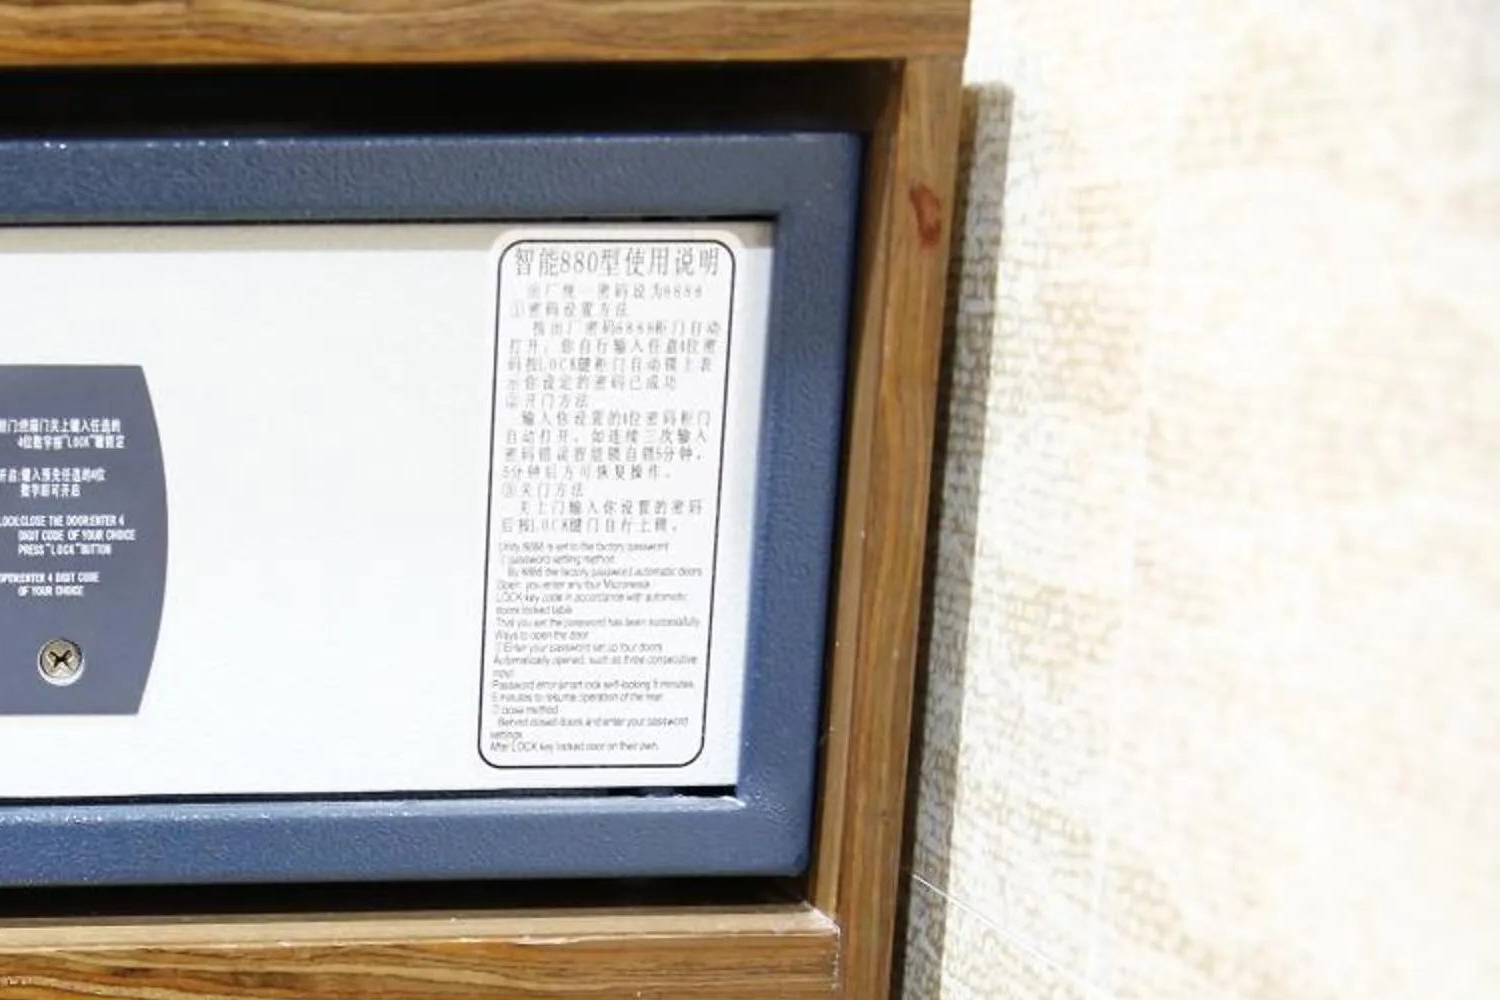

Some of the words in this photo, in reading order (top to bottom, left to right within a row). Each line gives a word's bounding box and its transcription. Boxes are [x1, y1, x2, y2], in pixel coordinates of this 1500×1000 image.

[516, 247, 719, 277] 智能880型使用说明
